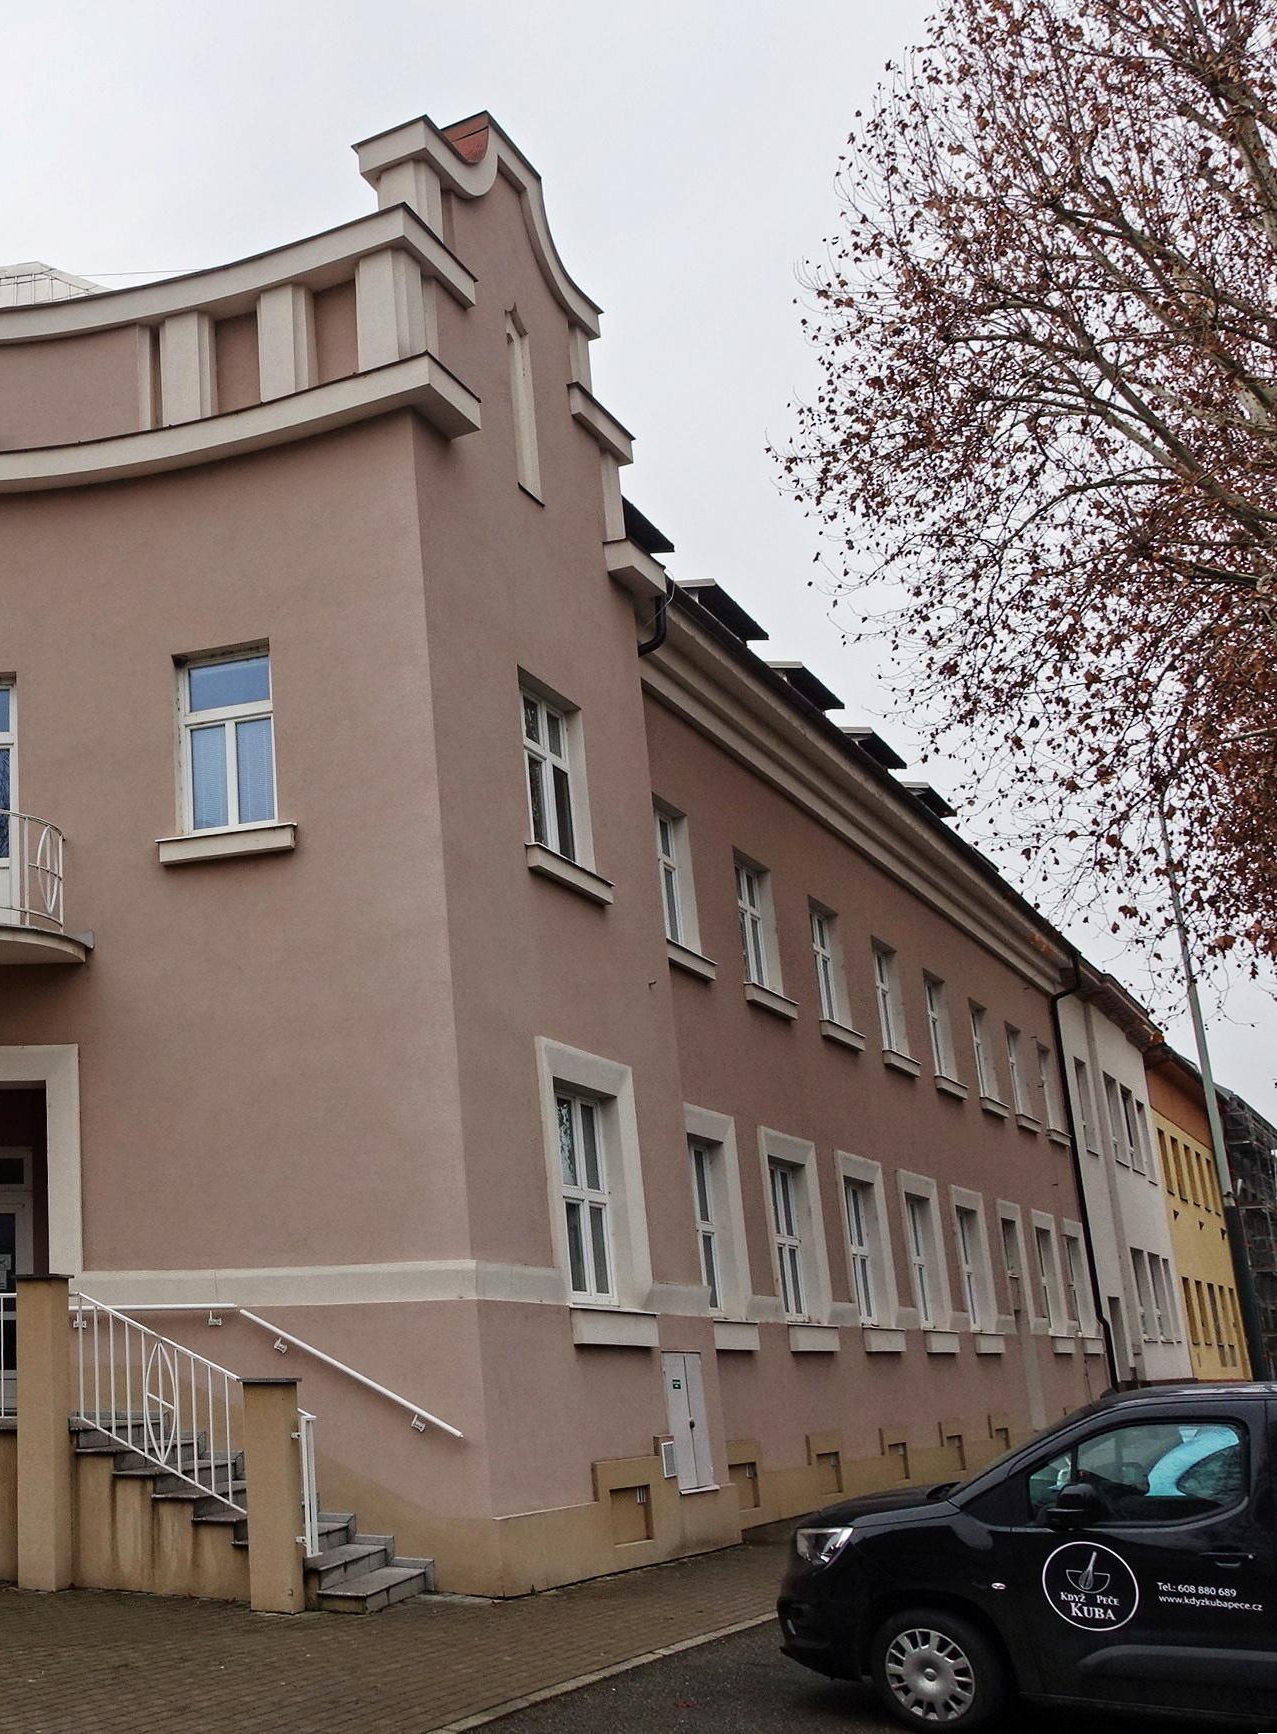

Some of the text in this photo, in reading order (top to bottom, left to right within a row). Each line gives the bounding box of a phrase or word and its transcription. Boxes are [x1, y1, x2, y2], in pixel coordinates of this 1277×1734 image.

[1178, 1584, 1196, 1594] 608
[1198, 1586, 1216, 1596] 880
[1218, 1588, 1237, 1598] 689
[1158, 1594, 1264, 1612] www.kdyzkubapece.cz
